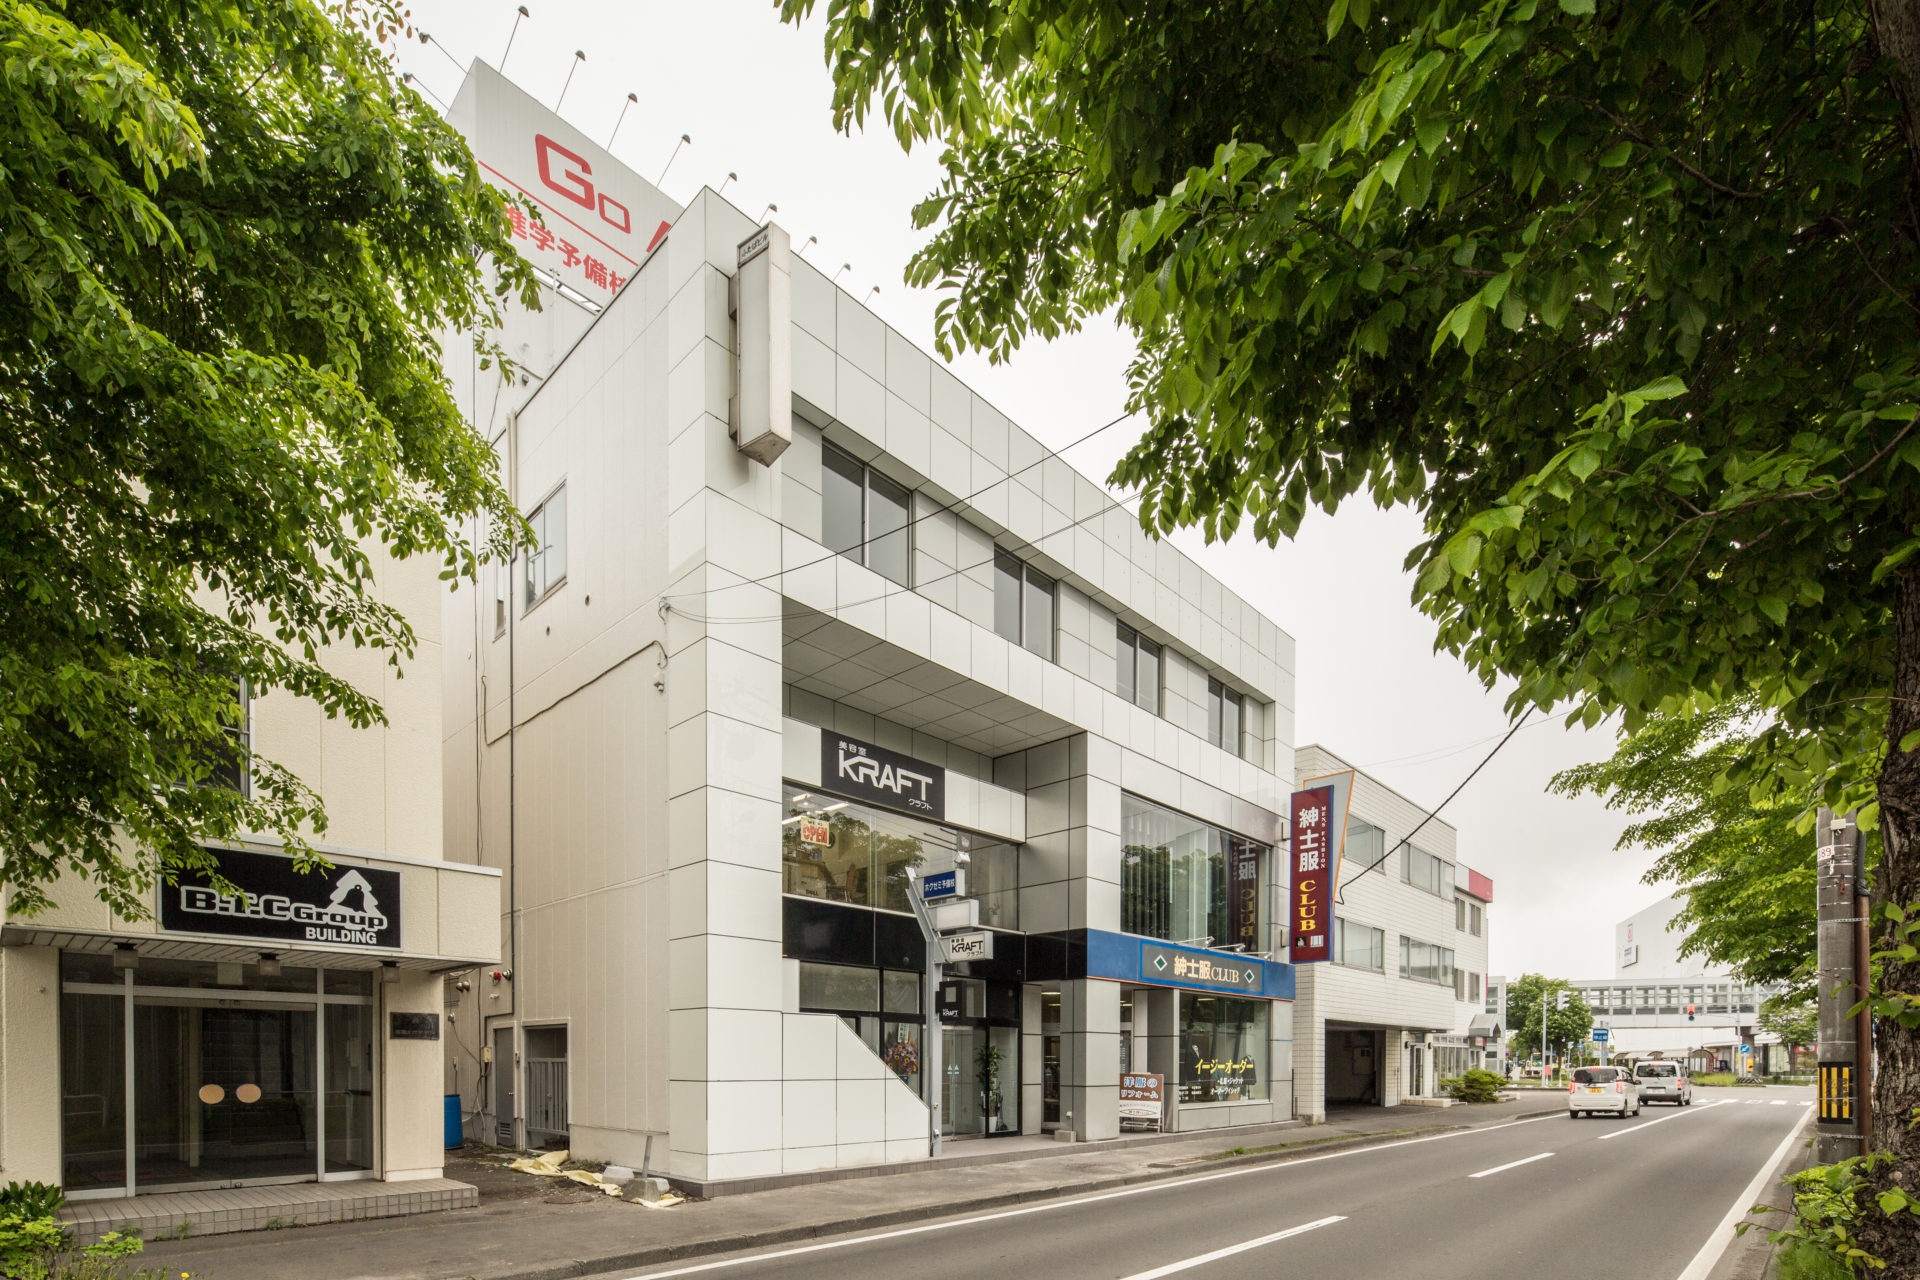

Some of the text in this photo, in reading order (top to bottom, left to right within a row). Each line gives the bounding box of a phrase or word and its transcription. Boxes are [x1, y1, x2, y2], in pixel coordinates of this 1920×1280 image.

[838, 740, 867, 756] 美容室
[838, 749, 933, 801] KRAFT
[908, 798, 933, 810] クラフト
[803, 824, 828, 844] OPEN
[1299, 807, 1319, 873] 紳士服
[924, 879, 956, 892] ホクゼミ予備校
[1299, 880, 1317, 932] CLUB
[290, 904, 387, 931] Group
[305, 927, 377, 945] BUILDING
[952, 941, 984, 954] KRAFT
[1194, 1058, 1254, 1075] イージーオーダー
[1123, 1076, 1158, 1088] 洋服の
[1120, 1089, 1159, 1099] リフォーム
